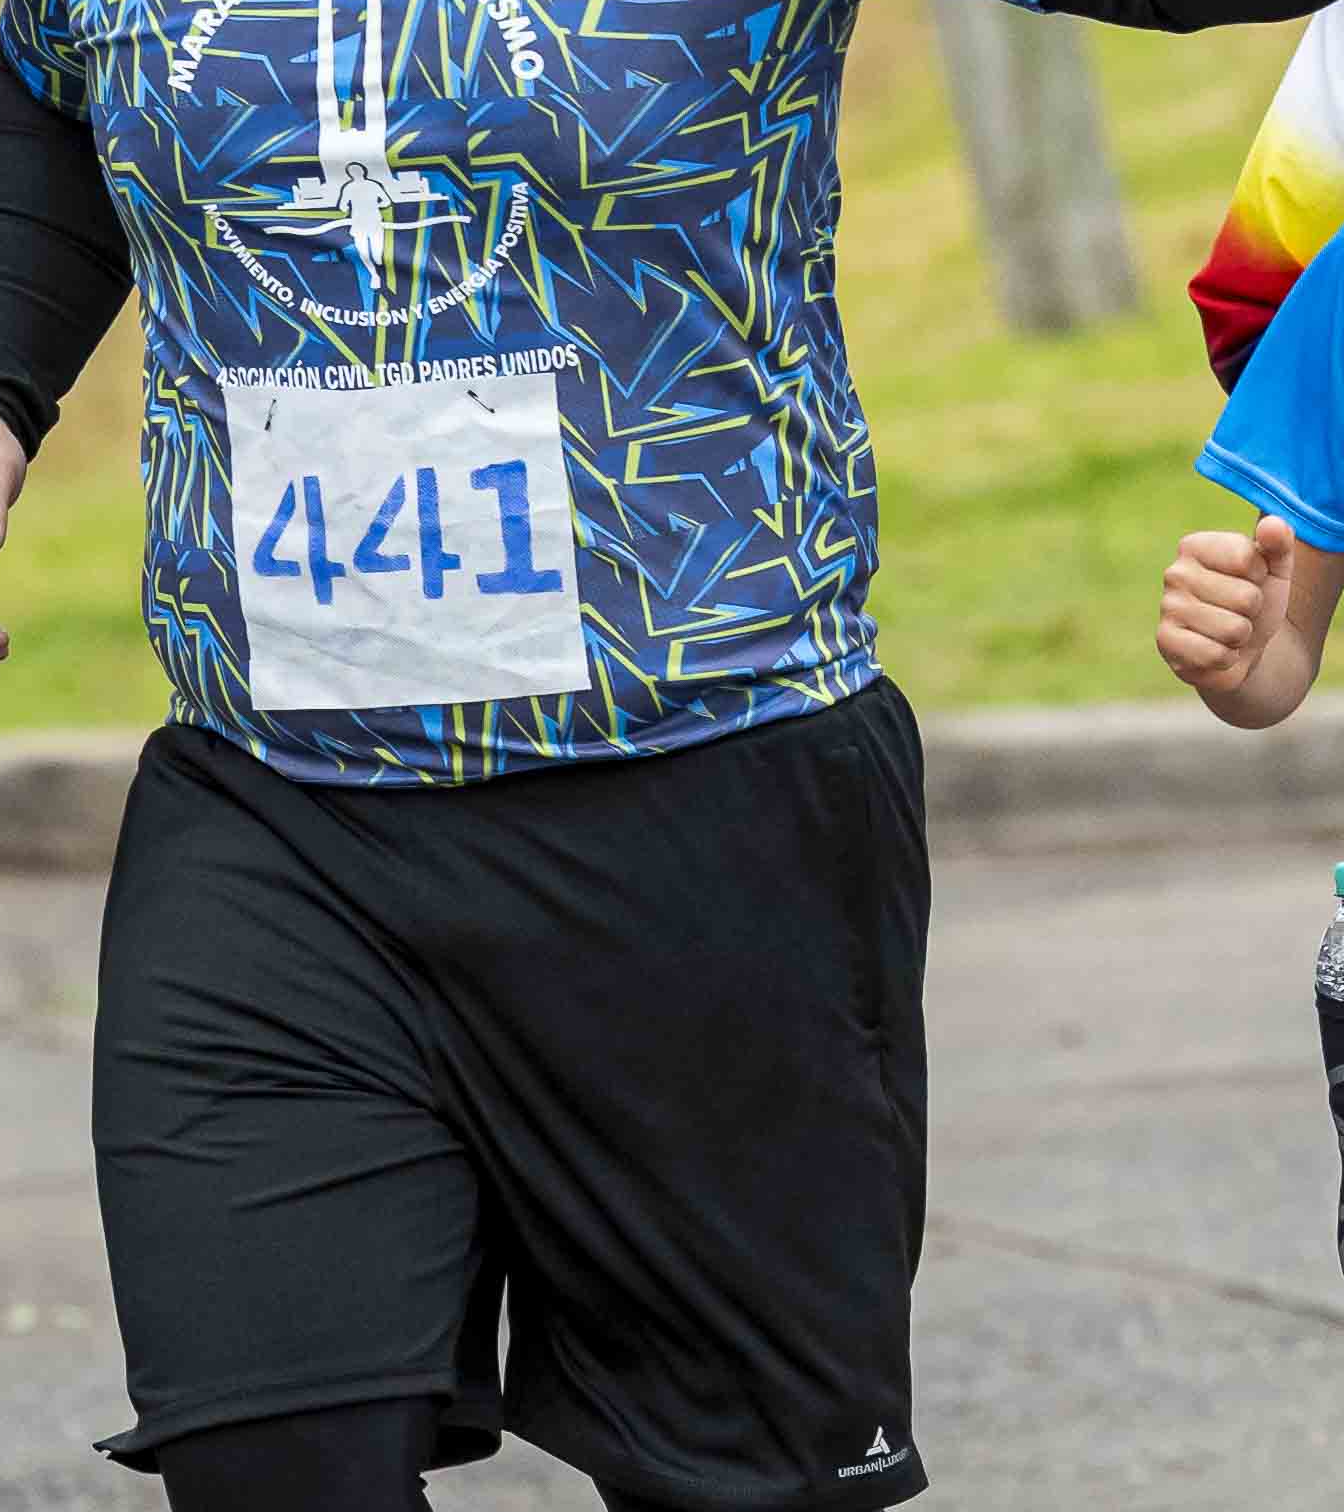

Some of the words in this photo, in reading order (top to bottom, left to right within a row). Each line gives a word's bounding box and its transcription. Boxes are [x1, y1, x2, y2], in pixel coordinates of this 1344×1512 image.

[493, 181, 529, 259] POSITIVA
[324, 364, 374, 390] CIVIL
[373, 361, 415, 387] TGD
[418, 355, 497, 385] PADRES
[500, 343, 579, 377] UNIDOS
[253, 459, 563, 606] 441
